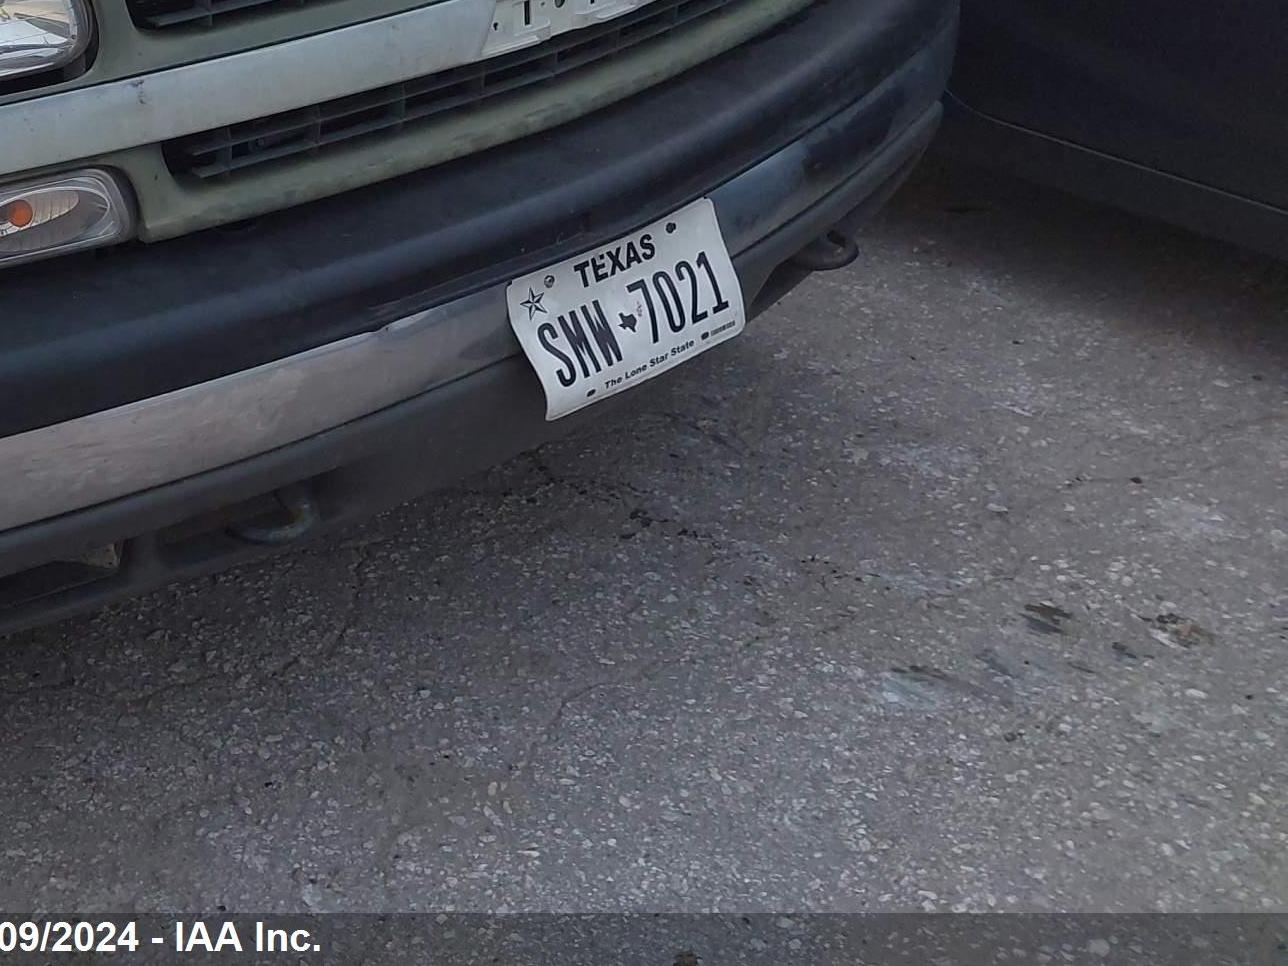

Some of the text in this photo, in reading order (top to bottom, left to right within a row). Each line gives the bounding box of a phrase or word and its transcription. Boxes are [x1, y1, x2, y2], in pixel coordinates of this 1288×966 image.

[573, 233, 656, 288] TEXAS
[537, 251, 730, 388] SMW 7021
[604, 339, 695, 389] The Lone Star State
